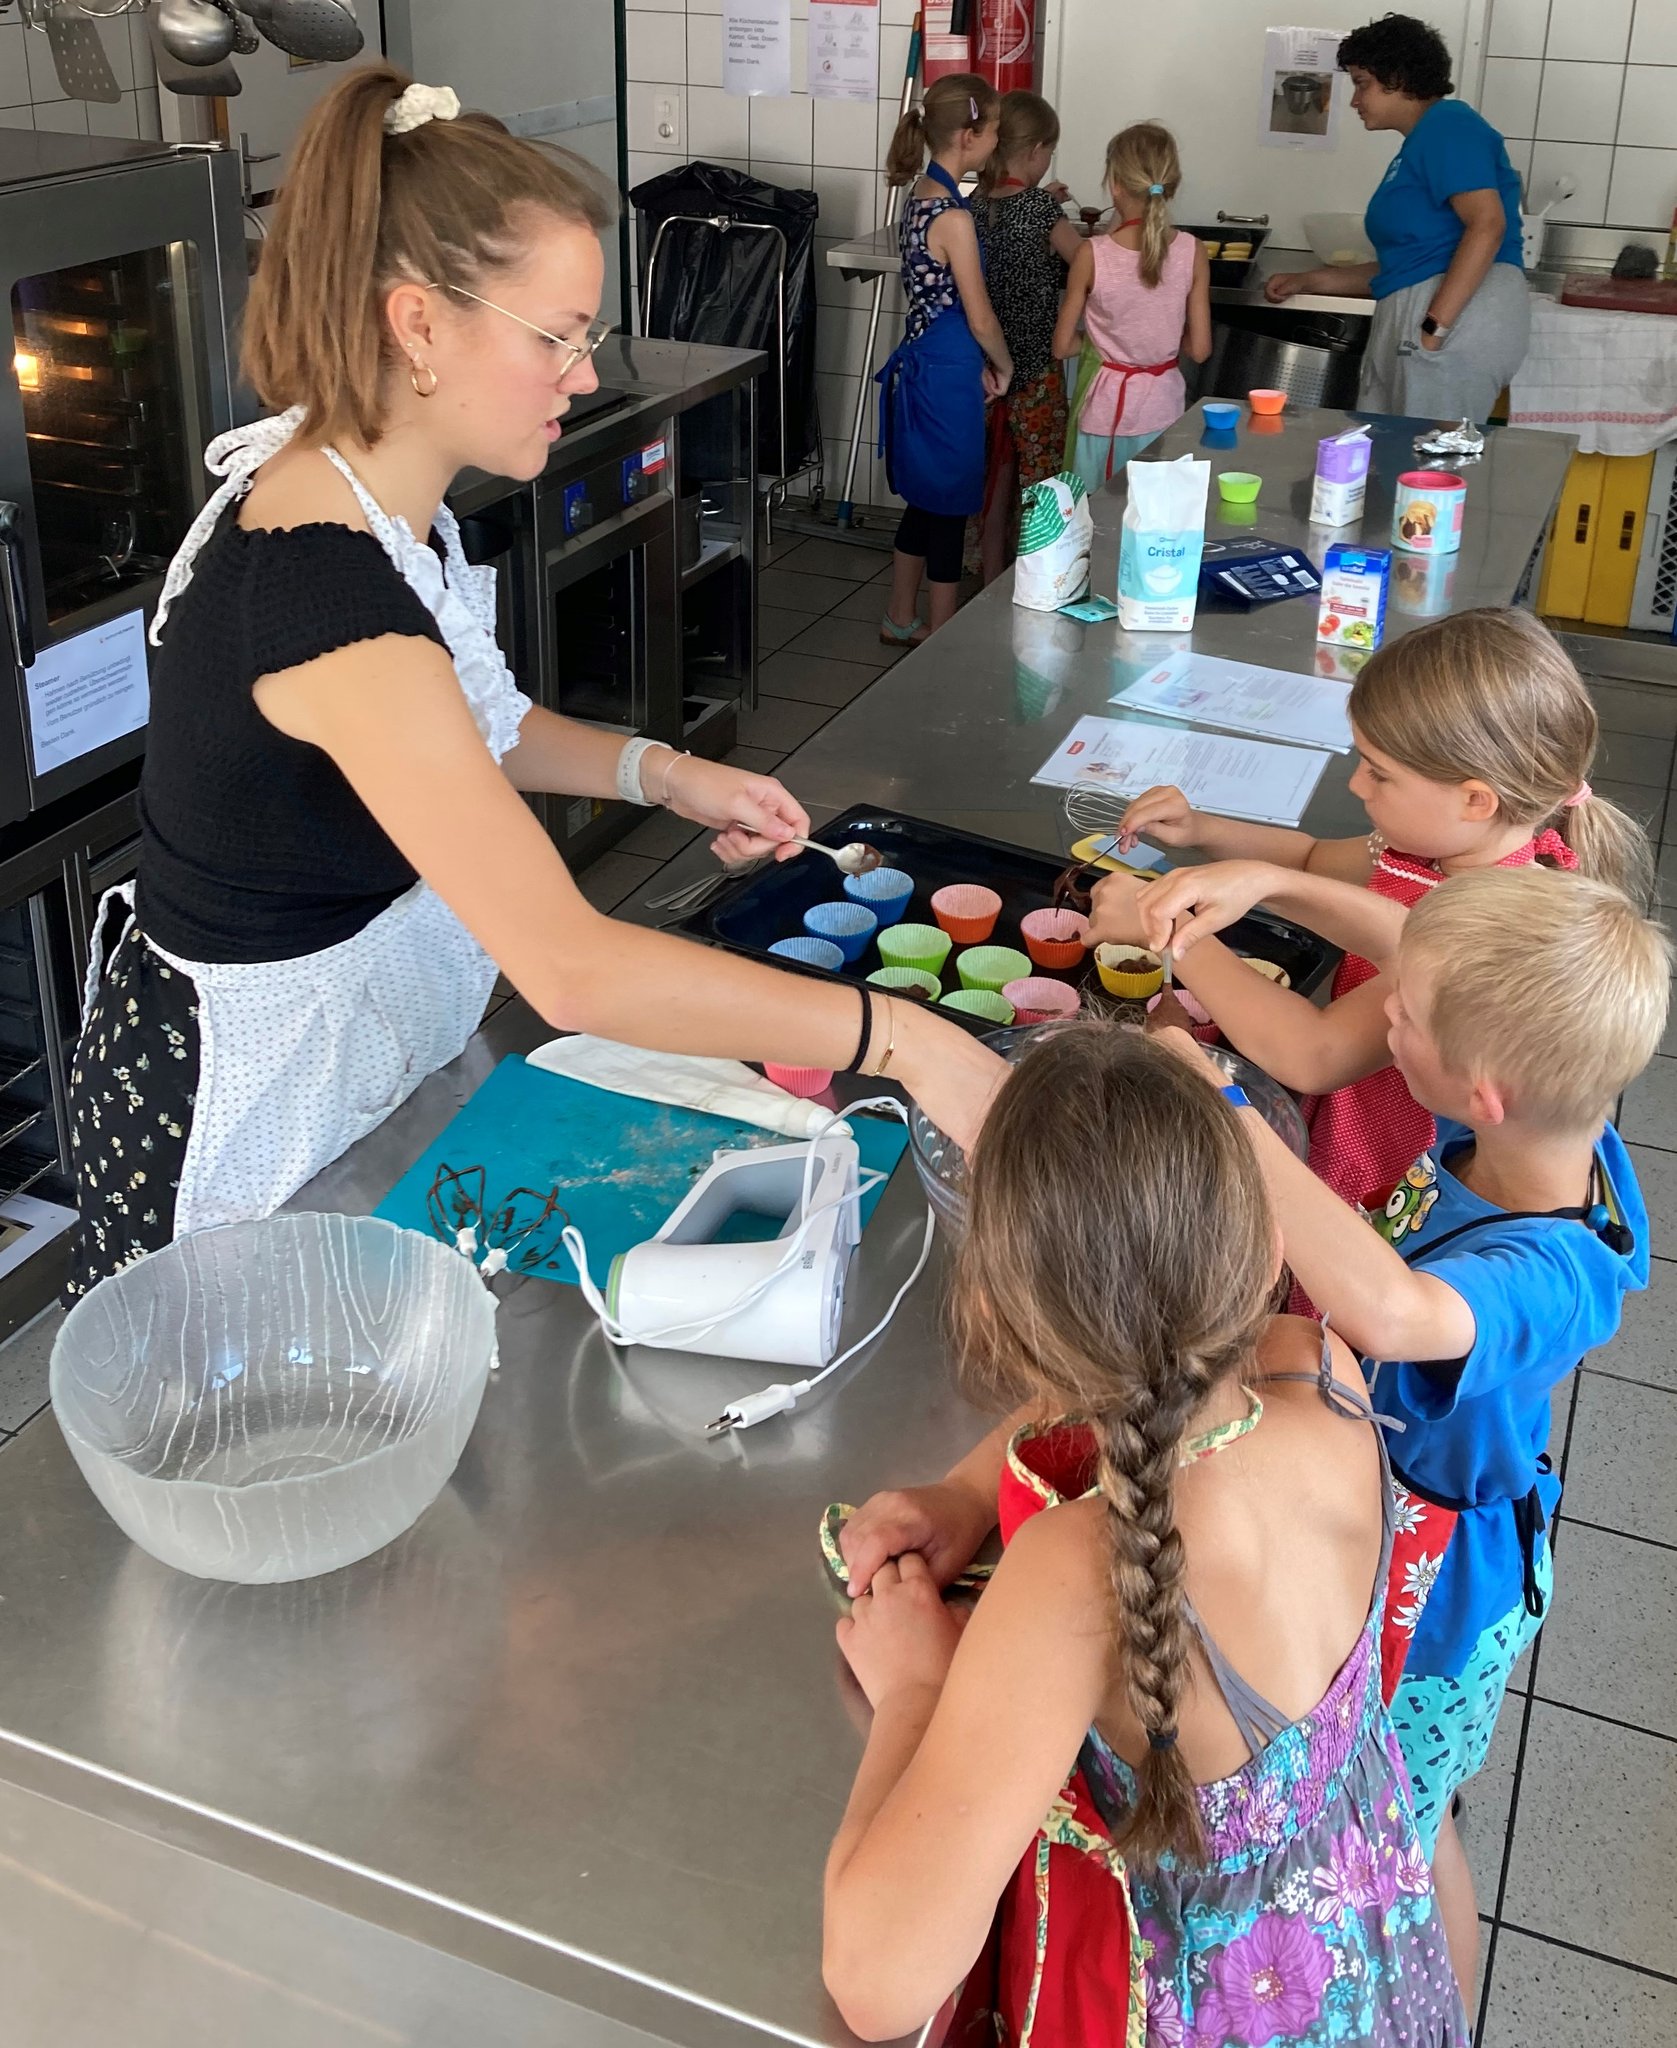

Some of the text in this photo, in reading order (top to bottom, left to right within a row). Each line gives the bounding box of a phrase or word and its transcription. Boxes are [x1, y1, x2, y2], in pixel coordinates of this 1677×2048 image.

[1147, 546, 1186, 558] Cristal
[34, 675, 60, 690] Steamer
[801, 1250, 816, 1269] BRAUN
